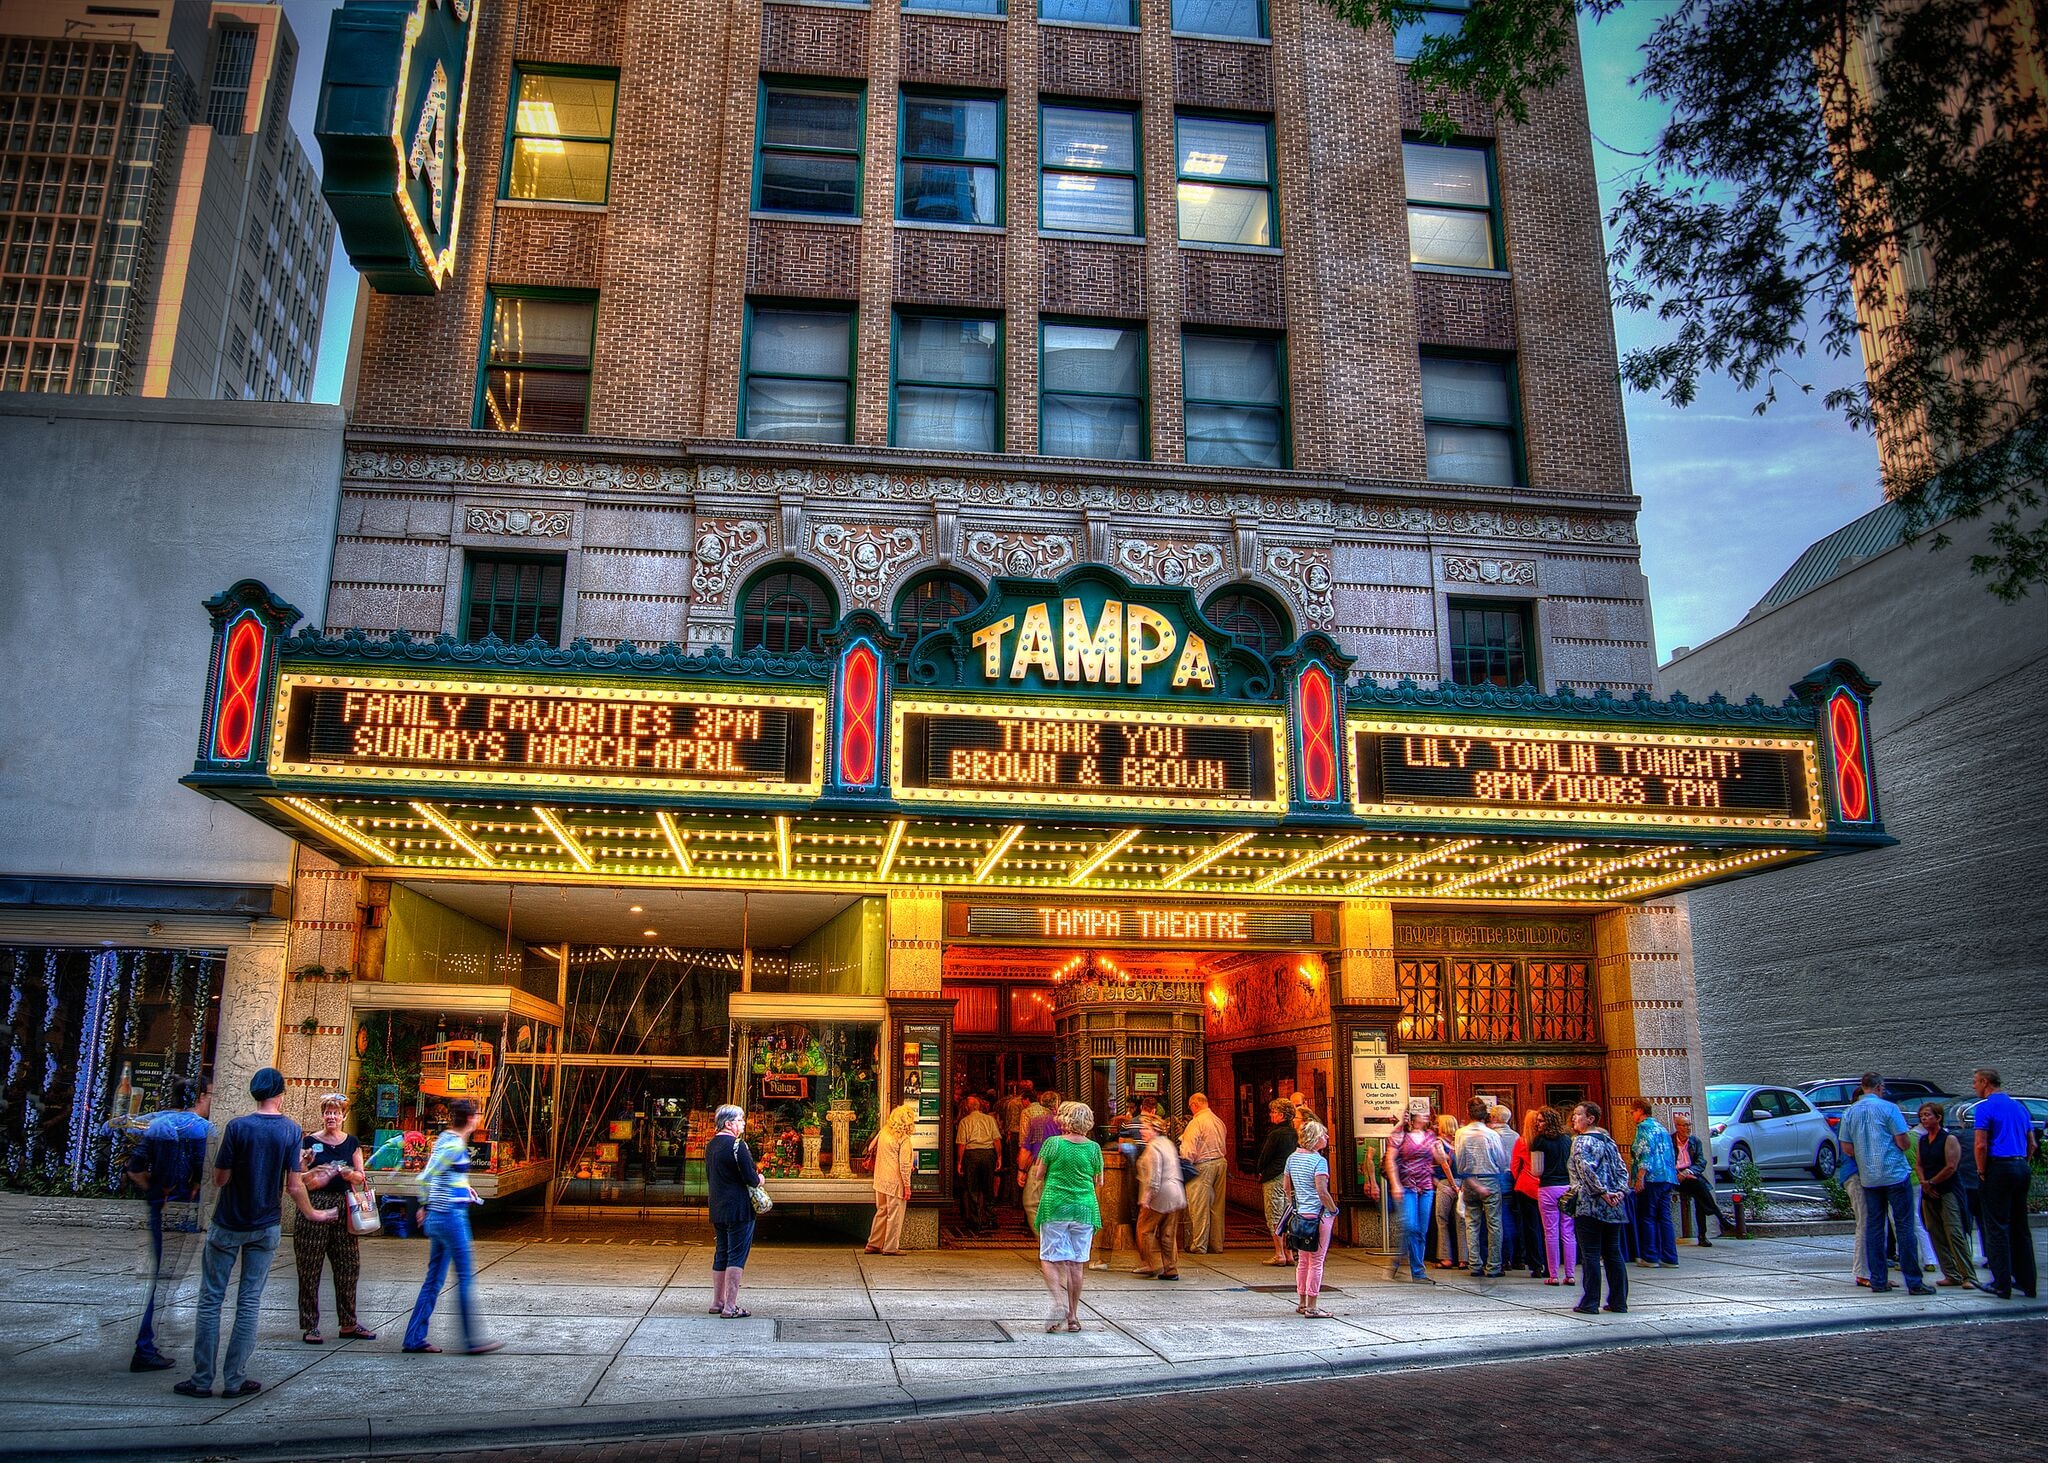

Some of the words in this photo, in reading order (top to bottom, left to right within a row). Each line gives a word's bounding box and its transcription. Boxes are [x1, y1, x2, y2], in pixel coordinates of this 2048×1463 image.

[972, 598, 1215, 688] TAMPA
[344, 692, 466, 727] FAMILY
[488, 698, 672, 736] FAVORITES
[694, 707, 759, 740] 3PM
[354, 726, 505, 762] SUNDAYS
[527, 733, 744, 772] MARCH-APRIL
[998, 720, 1100, 754] THANK
[1122, 725, 1183, 757] YOU
[952, 750, 1056, 784] BROWN
[1078, 755, 1101, 785] &
[1122, 757, 1224, 790] BROWN
[1405, 737, 1471, 768] LILY
[1491, 741, 1597, 773] TOMLIN
[1614, 747, 1742, 779] TONIGHT!
[1475, 771, 1646, 804] 8PM/DOORS
[1663, 779, 1720, 808] 7PM
[1039, 908, 1121, 937] TAMPA
[1136, 910, 1248, 939] THEATRE
[1396, 925, 1443, 944] TAMPA
[1507, 926, 1570, 945] BUILDING
[769, 1081, 797, 1093] Nature
